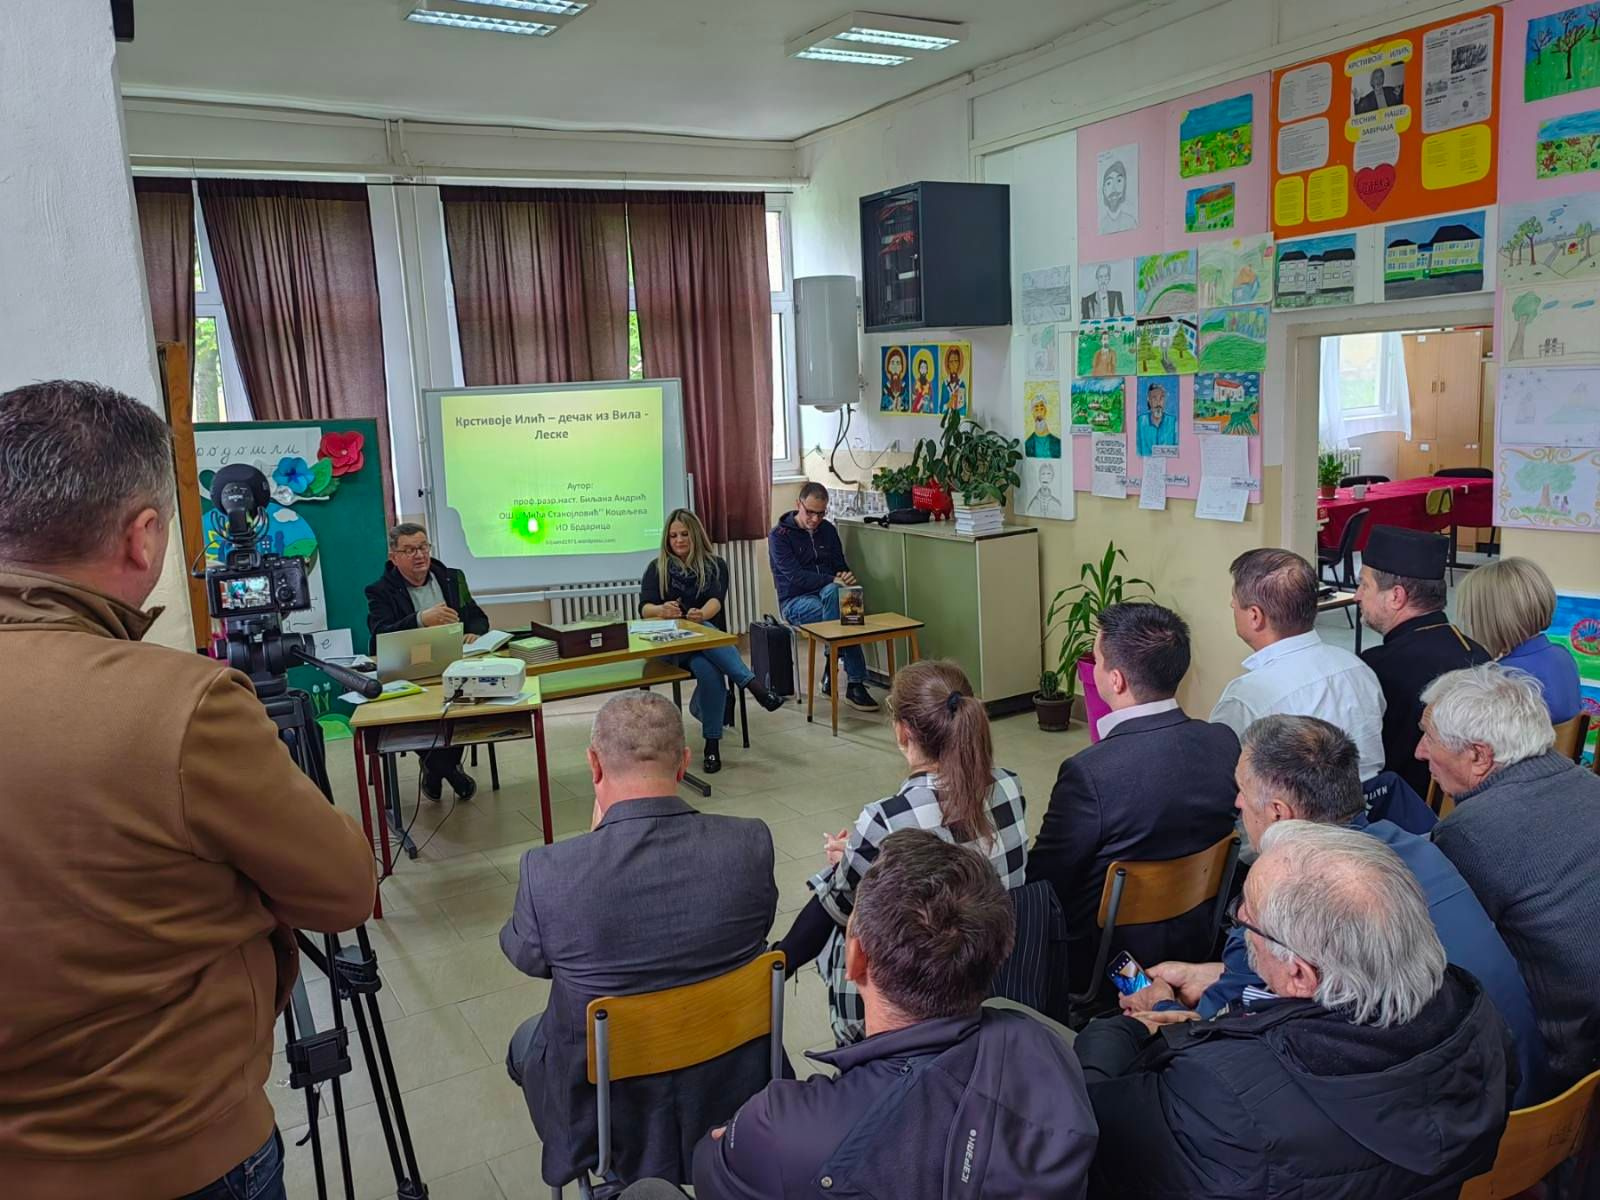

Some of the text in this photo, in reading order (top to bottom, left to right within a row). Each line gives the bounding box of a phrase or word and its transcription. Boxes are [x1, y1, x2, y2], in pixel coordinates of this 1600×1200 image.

[455, 415, 512, 428] Крстивоје
[515, 413, 545, 424] Илић
[558, 413, 593, 424] дечак
[596, 413, 609, 421] из
[612, 410, 641, 420] Вила
[534, 430, 569, 440] Леске
[567, 482, 594, 492] Аутор:
[579, 495, 613, 503] Биљана
[614, 494, 647, 502] Андрић
[498, 511, 514, 520] ОШ
